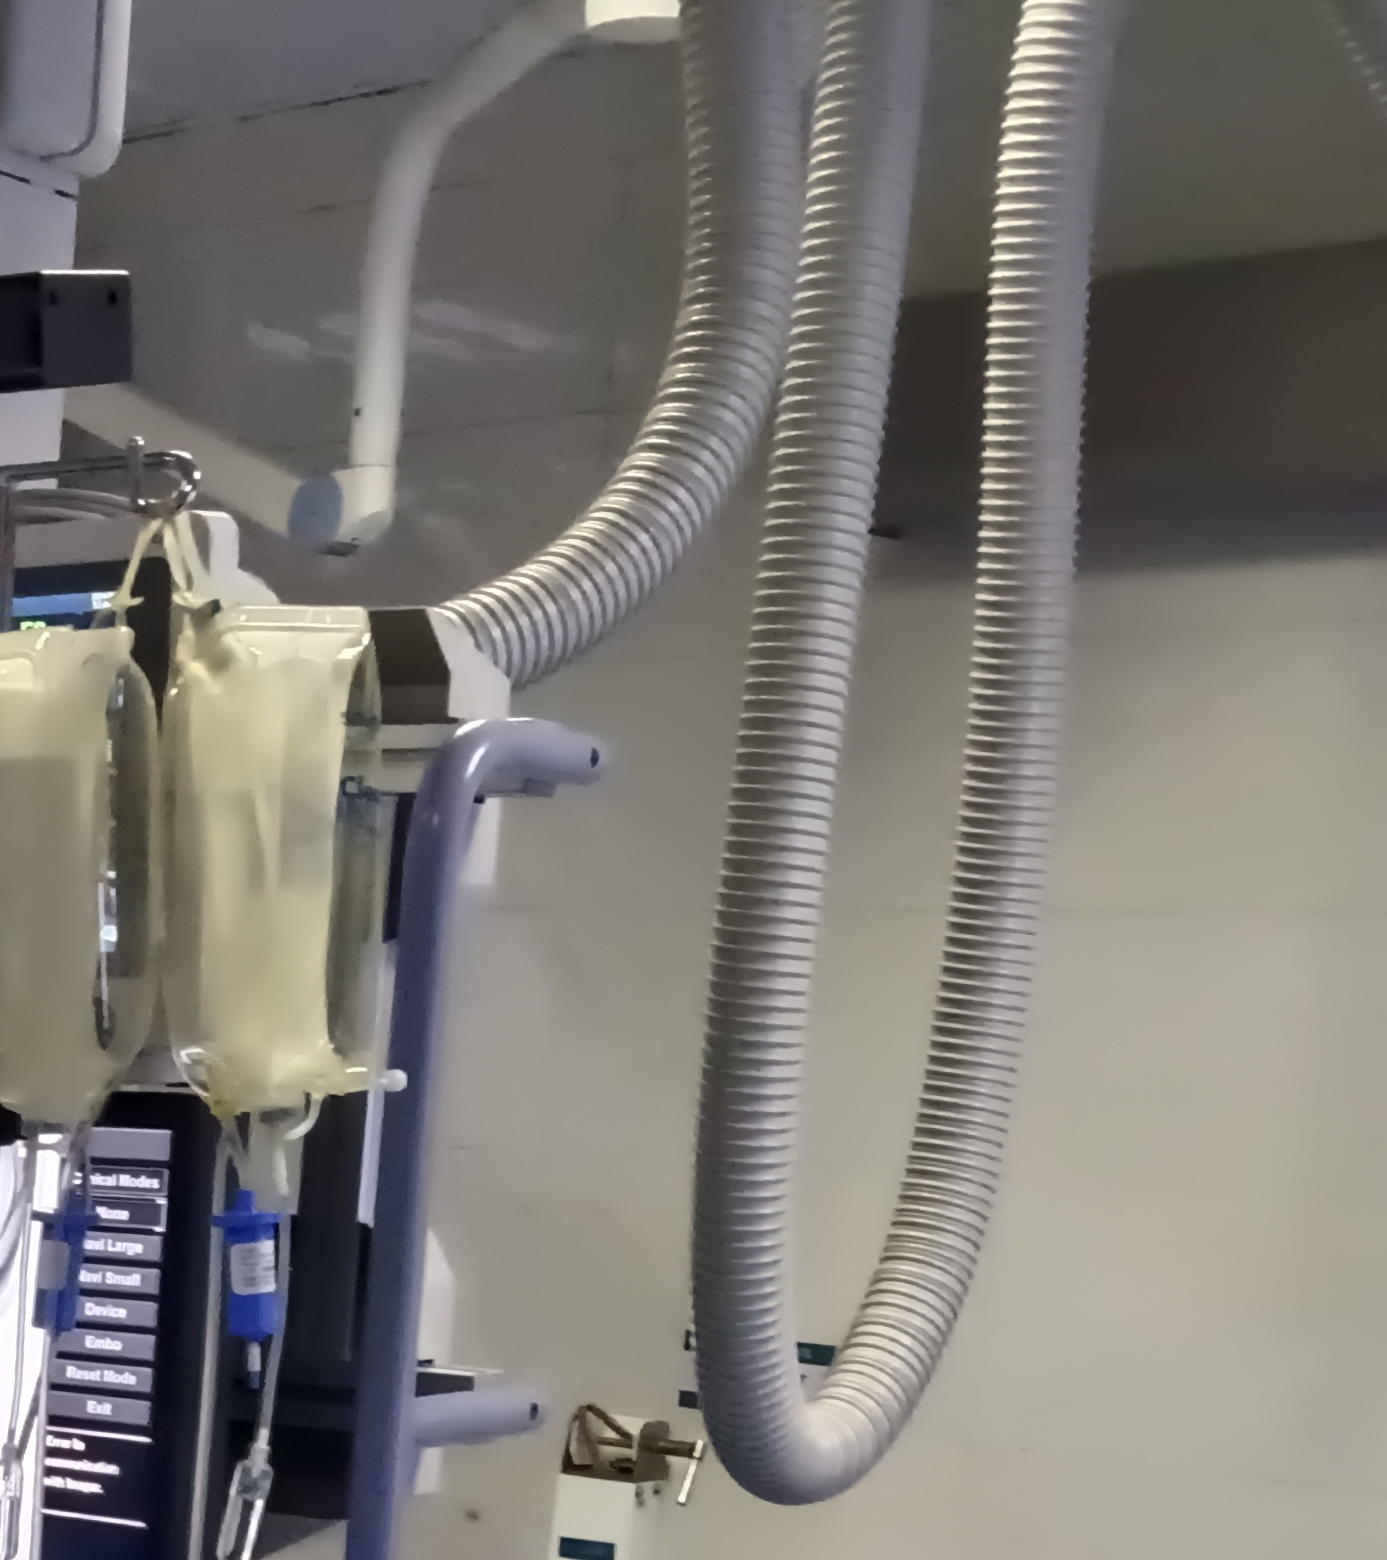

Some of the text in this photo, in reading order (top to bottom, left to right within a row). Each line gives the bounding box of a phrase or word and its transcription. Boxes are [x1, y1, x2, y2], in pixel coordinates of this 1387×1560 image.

[119, 1174, 160, 1189] Modes
[107, 1239, 144, 1256] Large
[104, 1271, 142, 1287] Small
[84, 1302, 127, 1319] Device
[84, 1334, 123, 1351] Embo
[66, 1365, 138, 1386] Reset Mode
[85, 1400, 113, 1416] Exit
